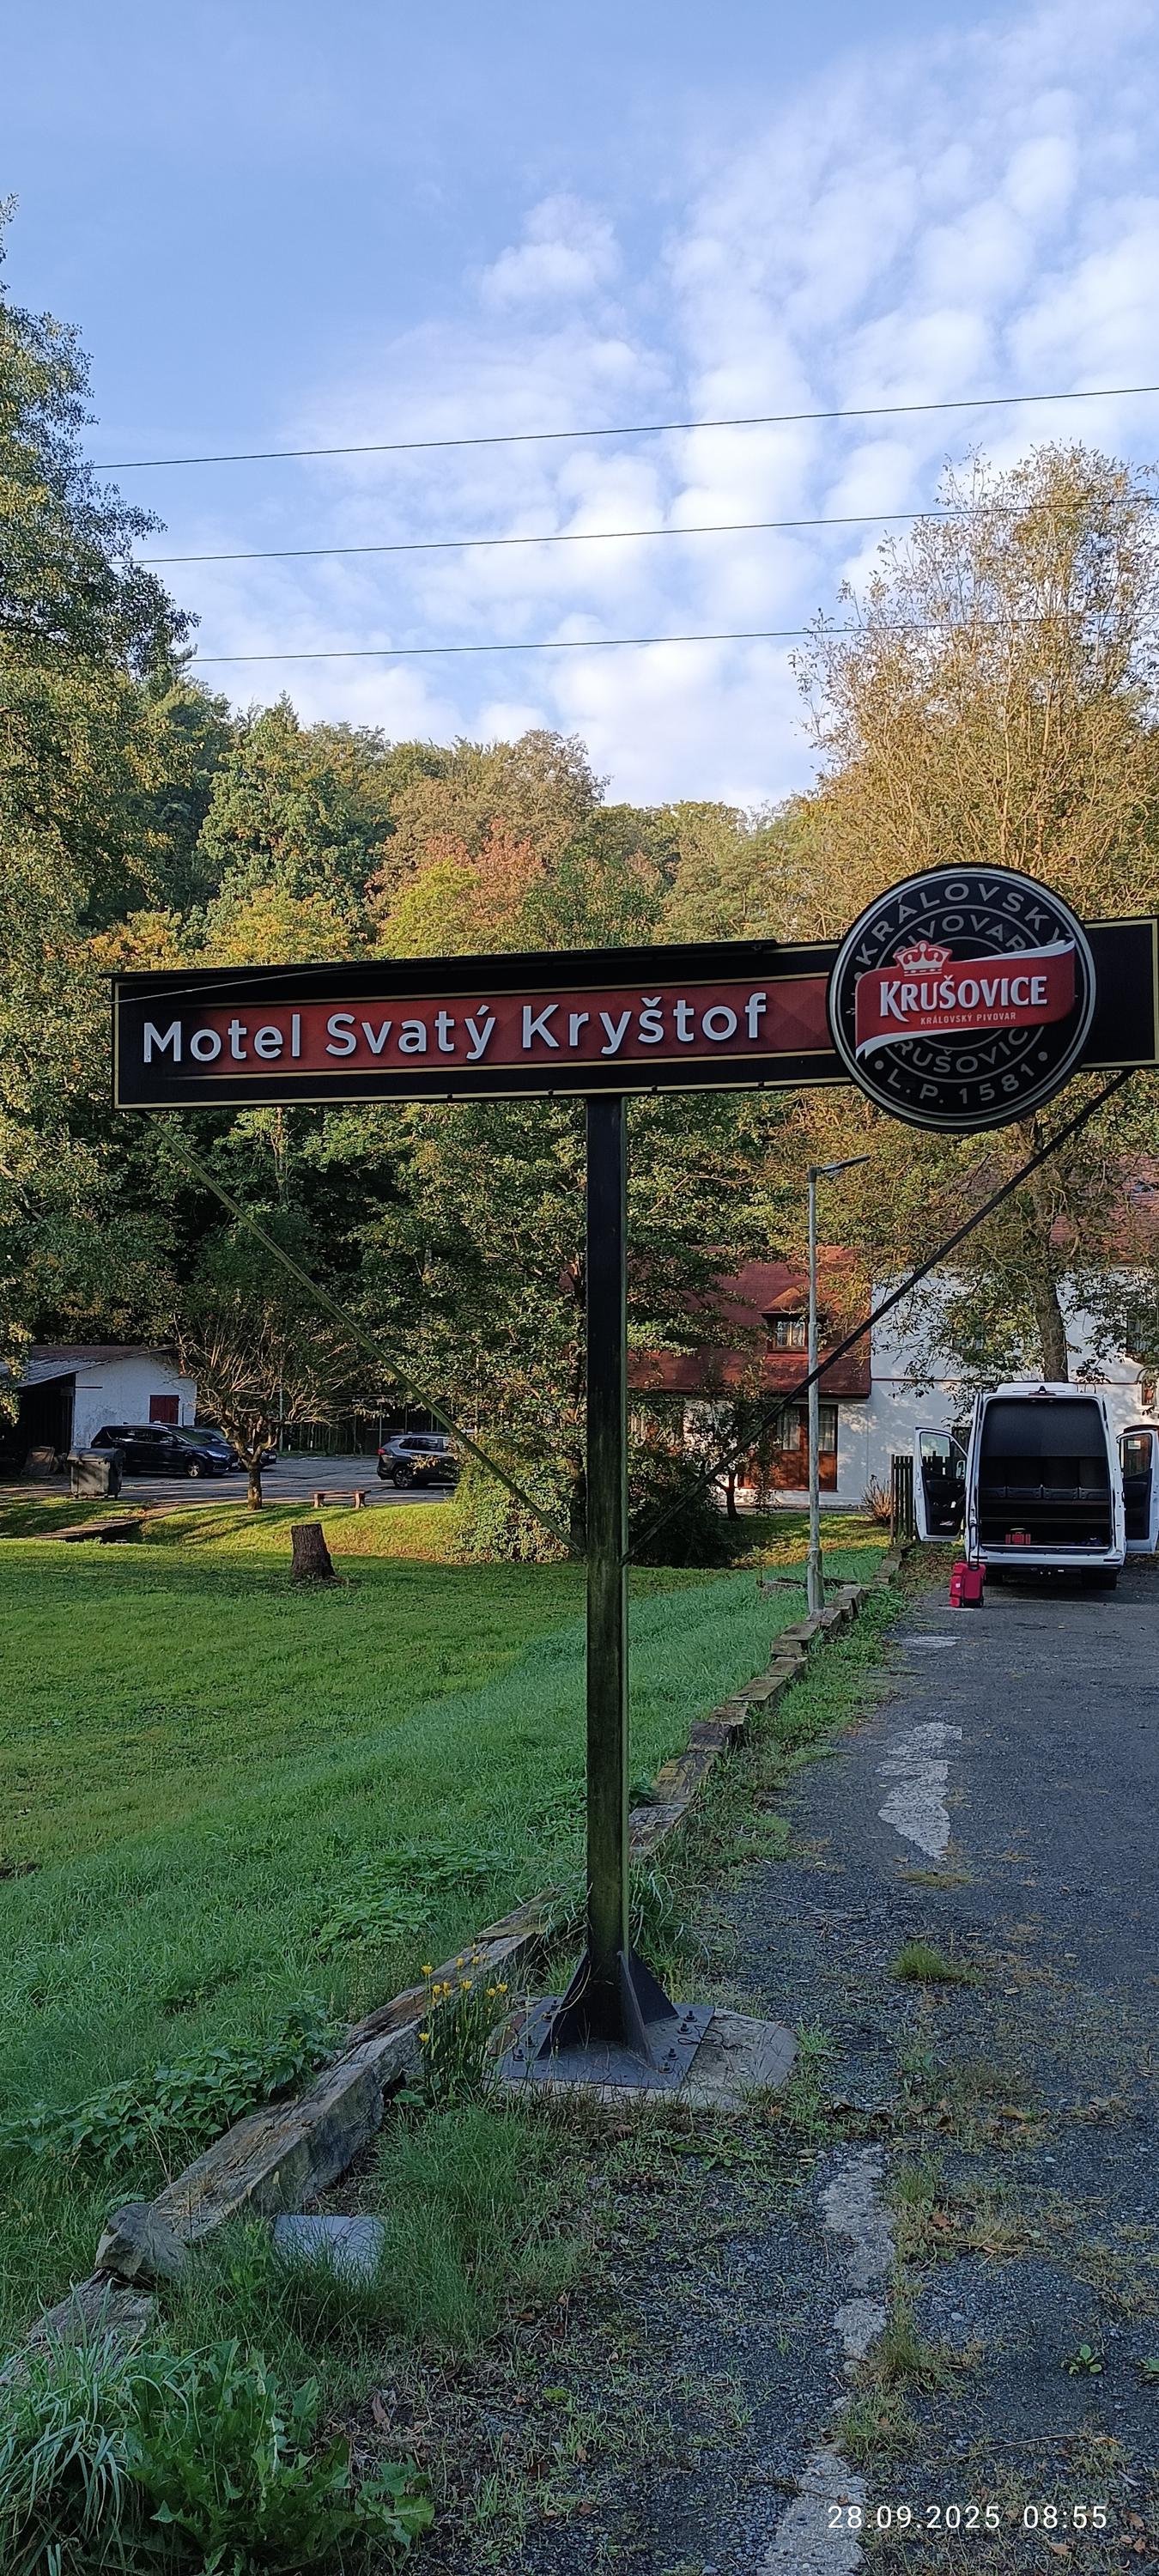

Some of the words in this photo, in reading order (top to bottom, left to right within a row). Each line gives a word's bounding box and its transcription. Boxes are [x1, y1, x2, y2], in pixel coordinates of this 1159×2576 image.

[855, 882, 1075, 966] KRÁLOVSKÝ
[879, 975, 1048, 1023] KRUŠOVICE
[920, 1012, 973, 1025] KRÁLOVSKÝ
[976, 1012, 1017, 1022] PIVOVAR
[143, 1013, 300, 1063] Motel
[325, 1005, 496, 1060] Svatý
[521, 992, 768, 1055] Kryštof
[895, 1028, 1029, 1073] RUŠOVIC
[959, 1062, 1035, 1104] 1581
